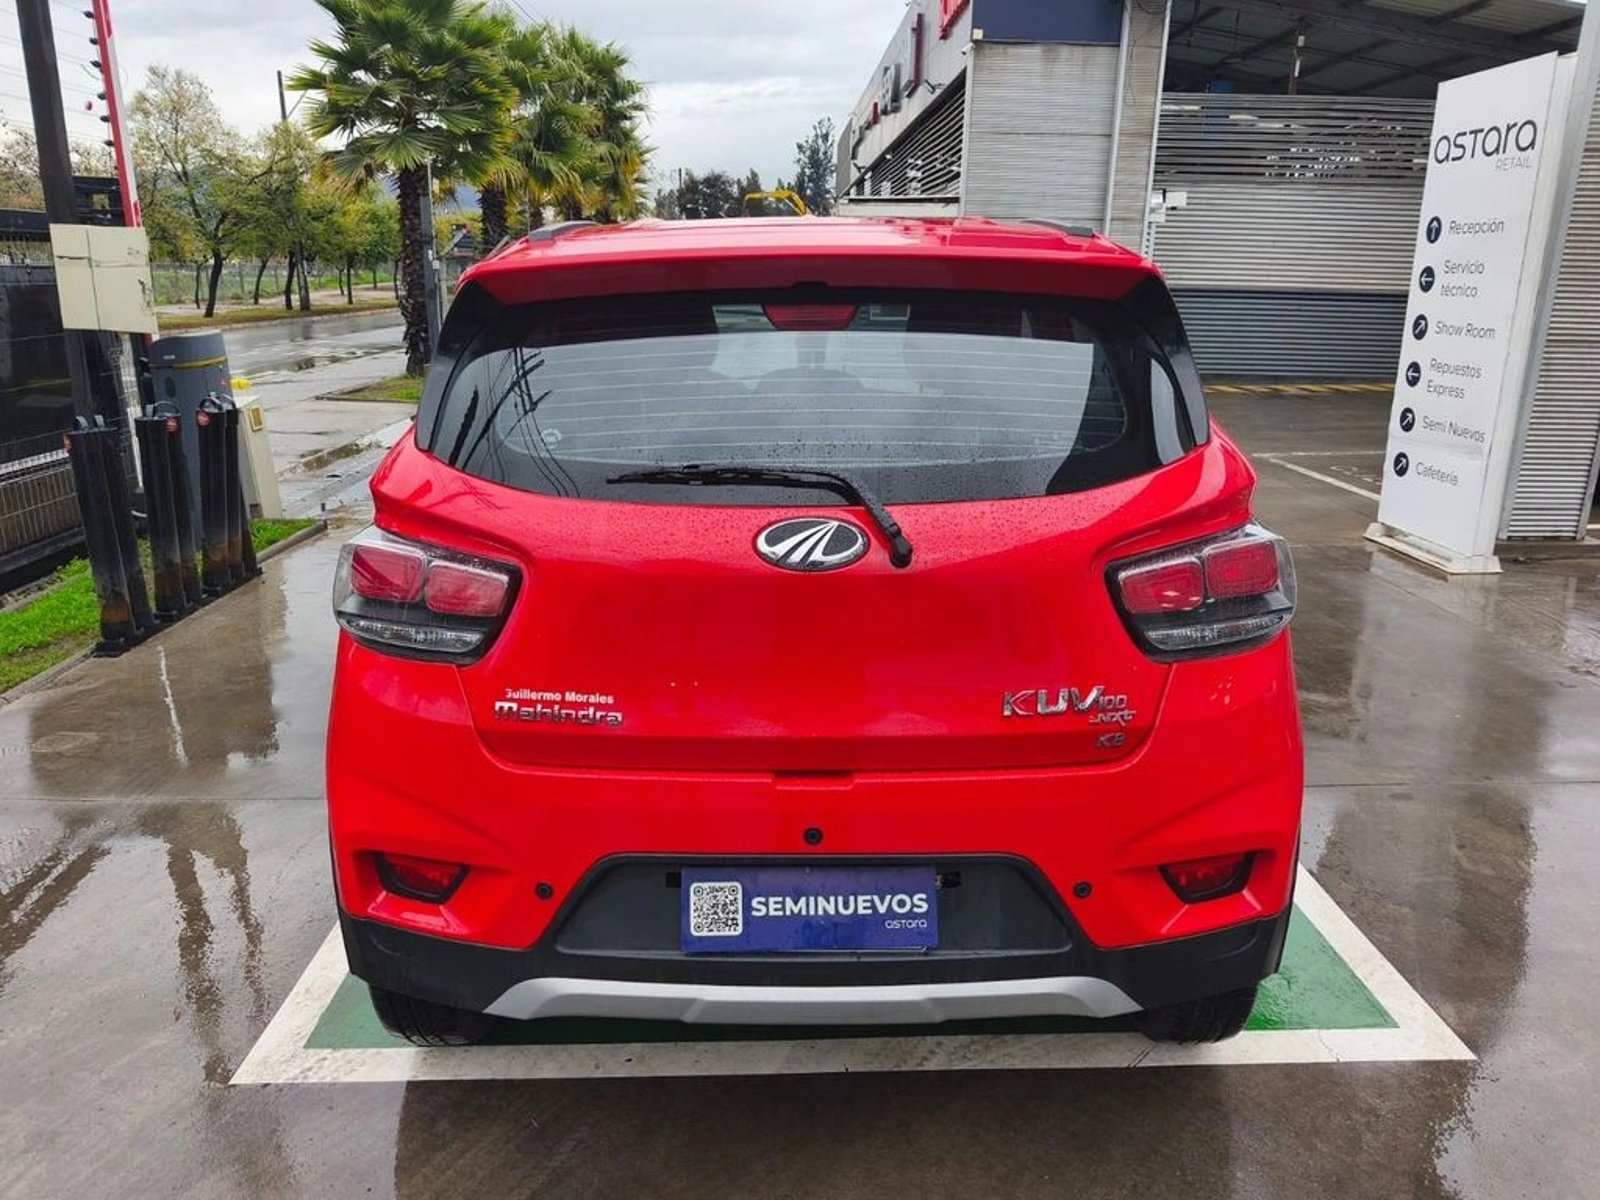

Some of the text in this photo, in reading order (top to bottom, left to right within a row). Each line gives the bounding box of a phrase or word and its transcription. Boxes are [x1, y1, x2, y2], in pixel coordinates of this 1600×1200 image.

[1434, 119, 1537, 164] astara
[1449, 217, 1505, 236] Recepción
[1443, 259, 1485, 275] Servicio
[1440, 282, 1478, 298] técnico
[1435, 320, 1496, 339] Show Room
[1429, 357, 1483, 379] Repuestos
[1426, 379, 1466, 400] Express
[1421, 415, 1486, 443] Semi Nuevos
[564, 690, 615, 705] Morales
[494, 700, 623, 725] Mahindra
[751, 894, 929, 917] SEMINUEVOS
[884, 918, 928, 930] astara
